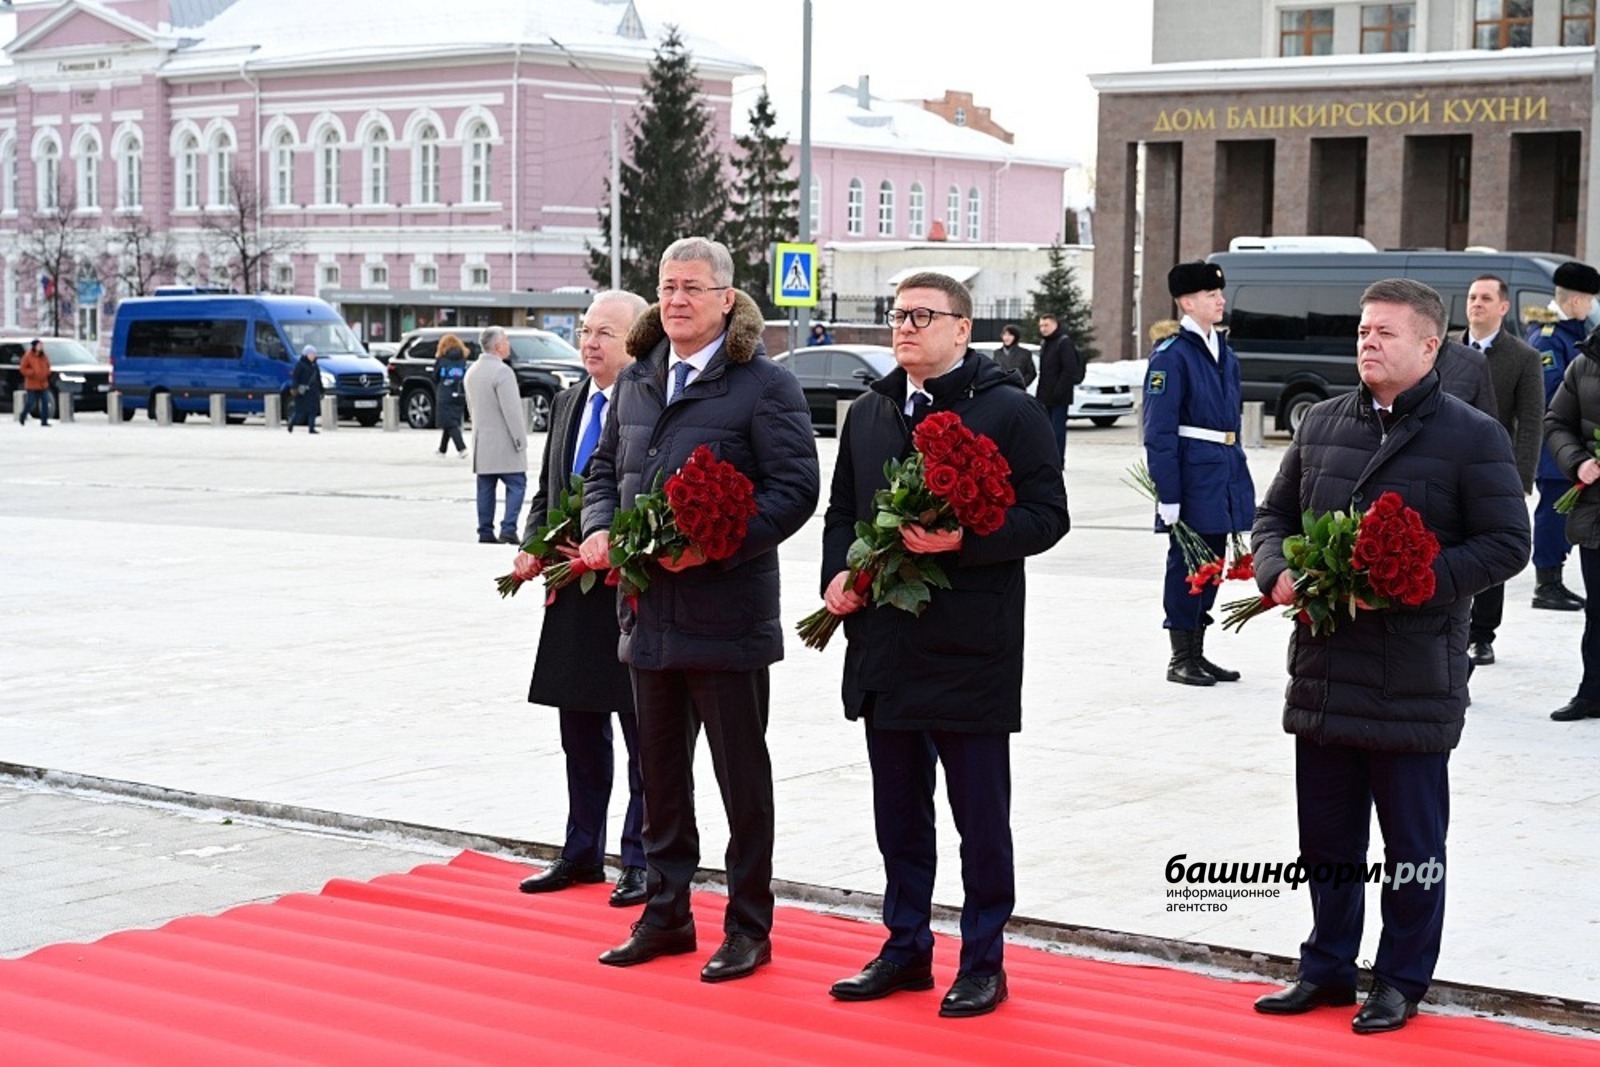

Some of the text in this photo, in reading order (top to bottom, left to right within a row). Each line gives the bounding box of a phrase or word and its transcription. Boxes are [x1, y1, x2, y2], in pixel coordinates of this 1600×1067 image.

[1153, 93, 1547, 132] ДОМ БАШКИРСКОЙ КУХНИ
